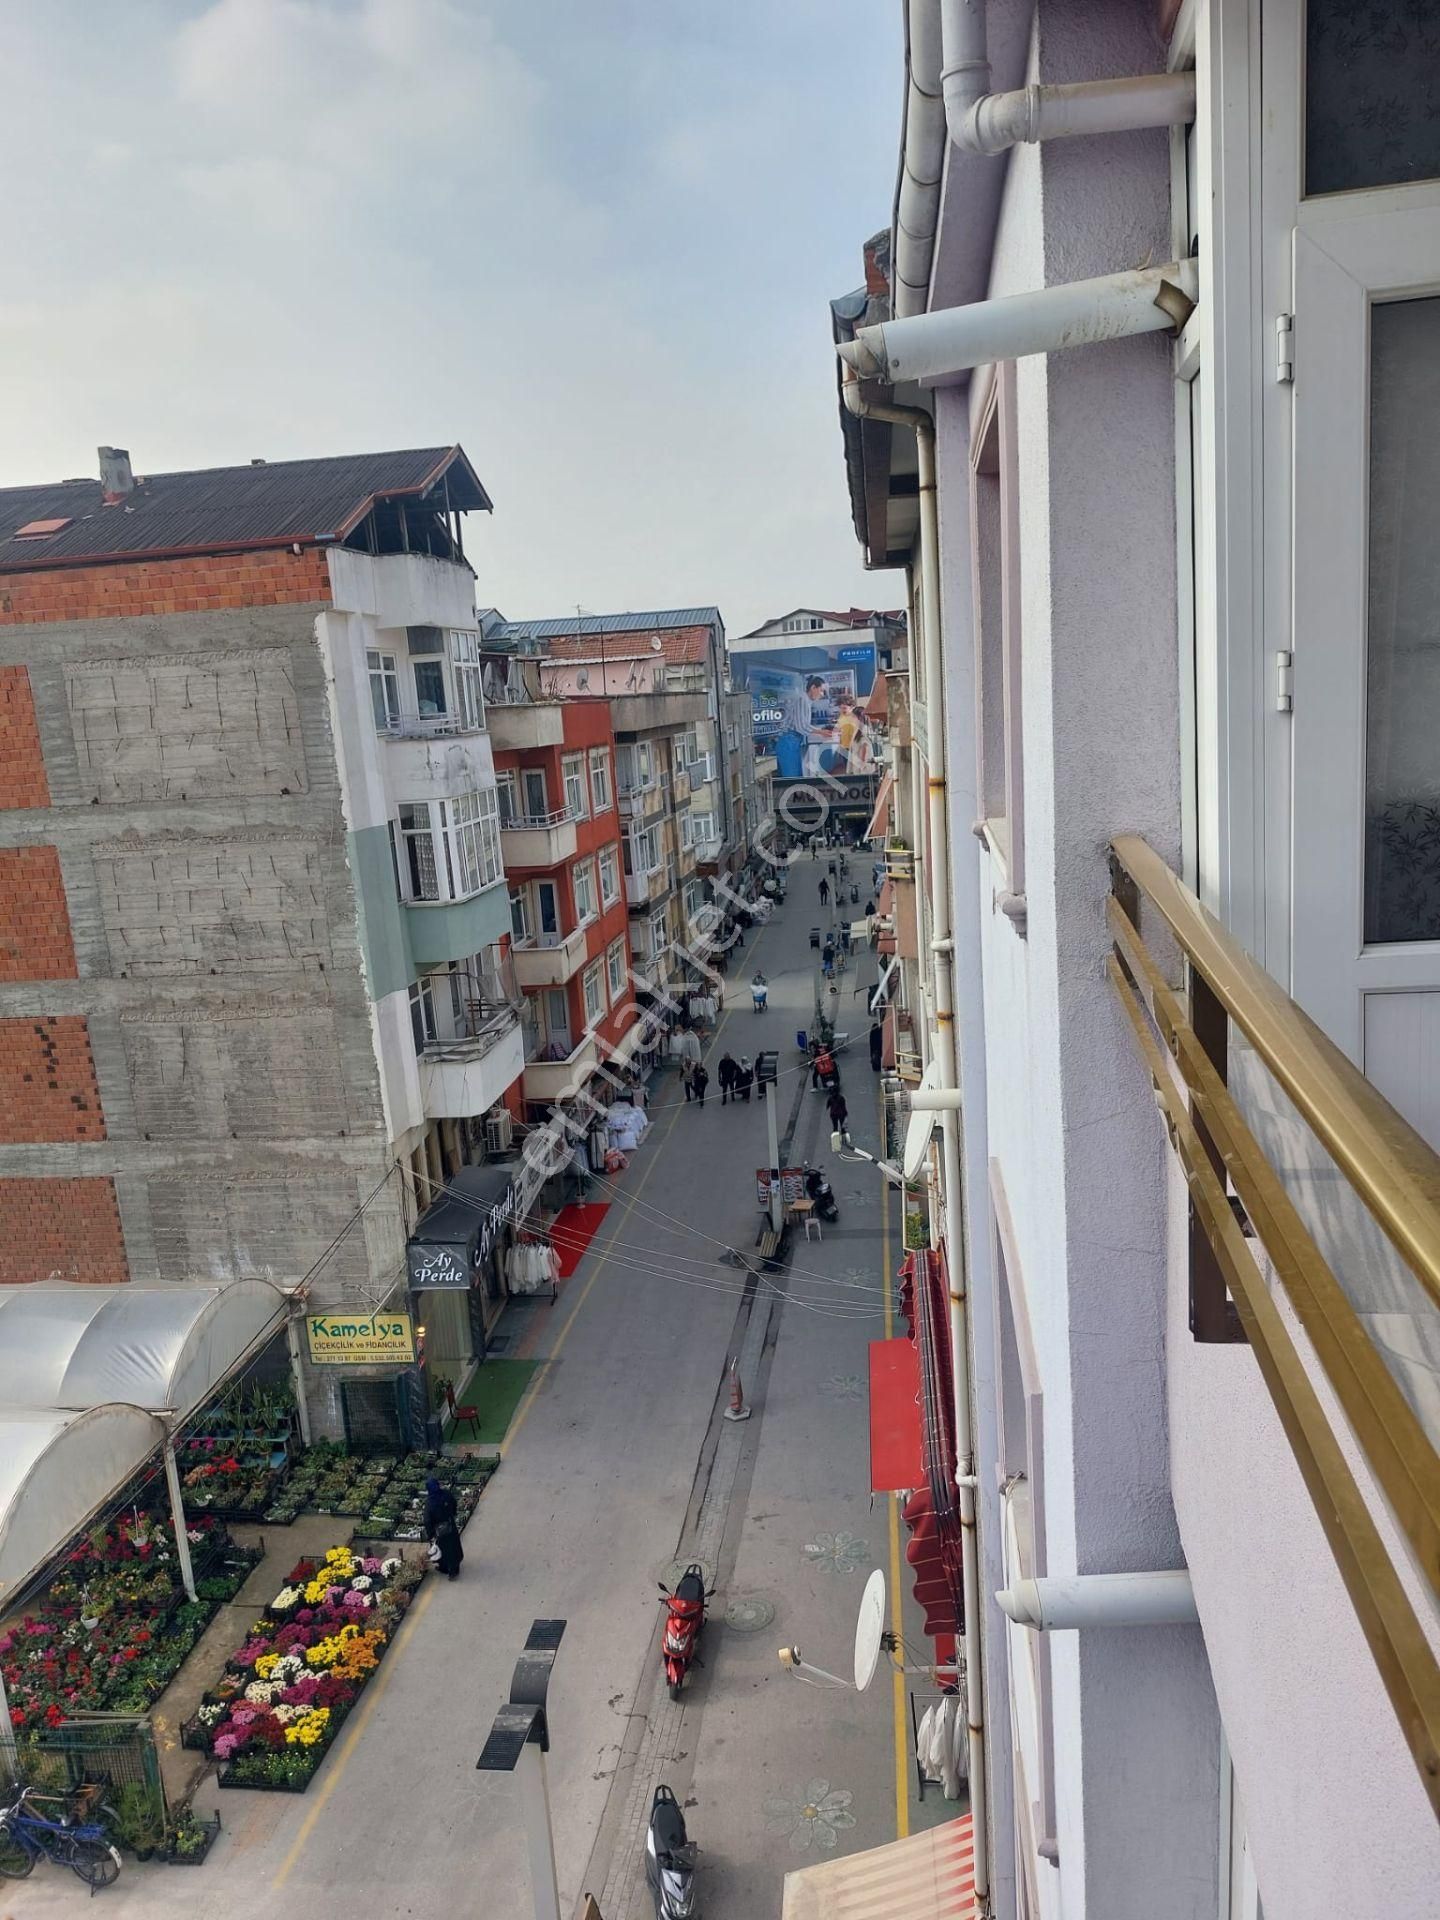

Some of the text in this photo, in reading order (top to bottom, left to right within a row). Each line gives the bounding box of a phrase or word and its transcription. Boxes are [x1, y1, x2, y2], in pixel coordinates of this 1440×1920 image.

[423, 1252, 452, 1271] Ay
[414, 1267, 463, 1282] Perde
[311, 1318, 403, 1341] Kamelya
